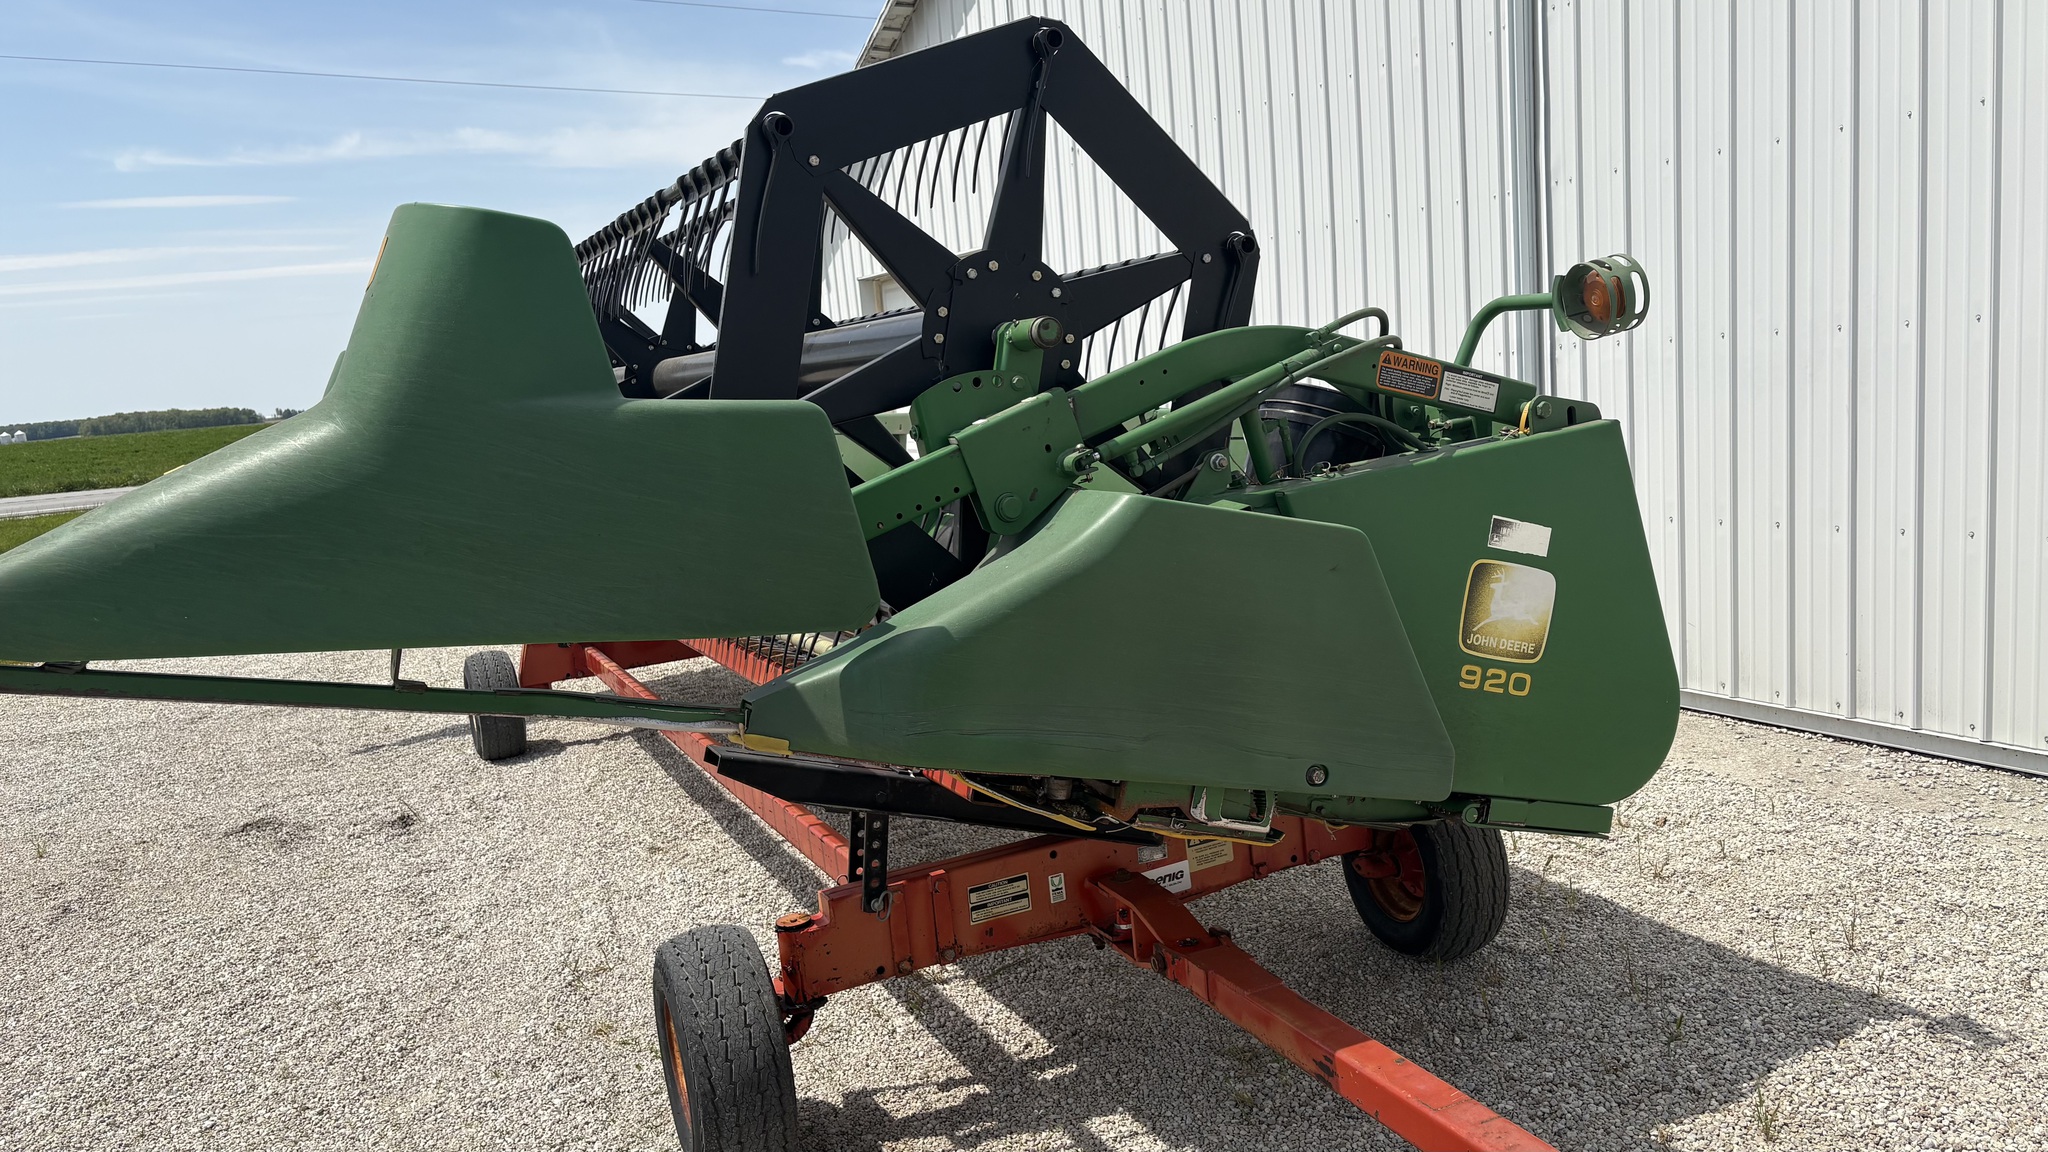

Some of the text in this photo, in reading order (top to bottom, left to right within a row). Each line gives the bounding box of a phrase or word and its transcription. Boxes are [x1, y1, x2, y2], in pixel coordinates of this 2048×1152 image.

[1393, 355, 1439, 375] WARNING
[1462, 370, 1483, 379] IMPORTANT
[1466, 633, 1536, 654] JOHN DEERE
[1459, 664, 1532, 697] 920
[988, 880, 1009, 889] CAUTION
[986, 896, 1013, 907] IMPORTANT
